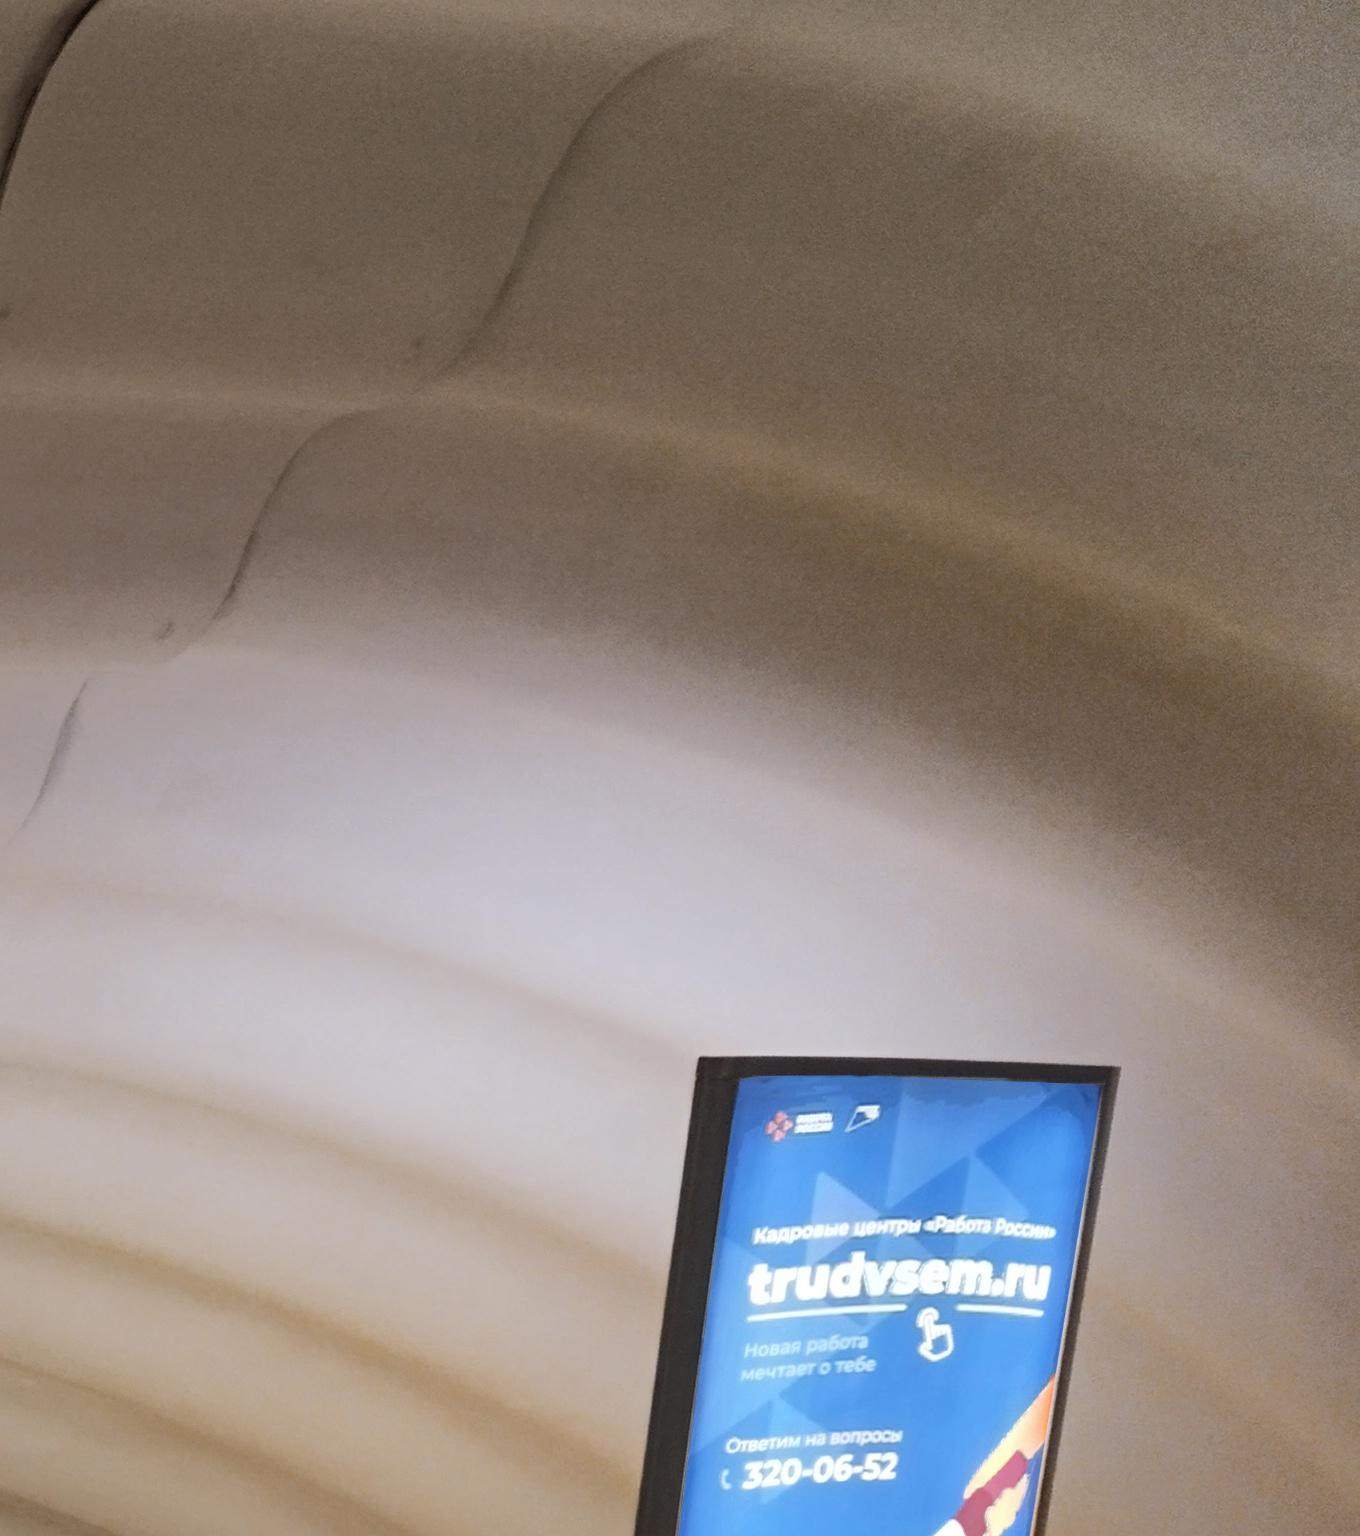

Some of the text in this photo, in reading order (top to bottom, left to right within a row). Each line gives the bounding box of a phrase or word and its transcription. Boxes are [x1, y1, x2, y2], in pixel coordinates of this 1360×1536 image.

[753, 1222, 849, 1246] Кадровые
[853, 1219, 921, 1239] центры
[747, 1251, 1052, 1306] trudvsem.ru
[744, 1334, 869, 1358] Новая работа
[741, 1355, 877, 1381] мечтает о тебе
[725, 1429, 904, 1454] Ответим на вопросы
[741, 1452, 899, 1490] 320-06-52
